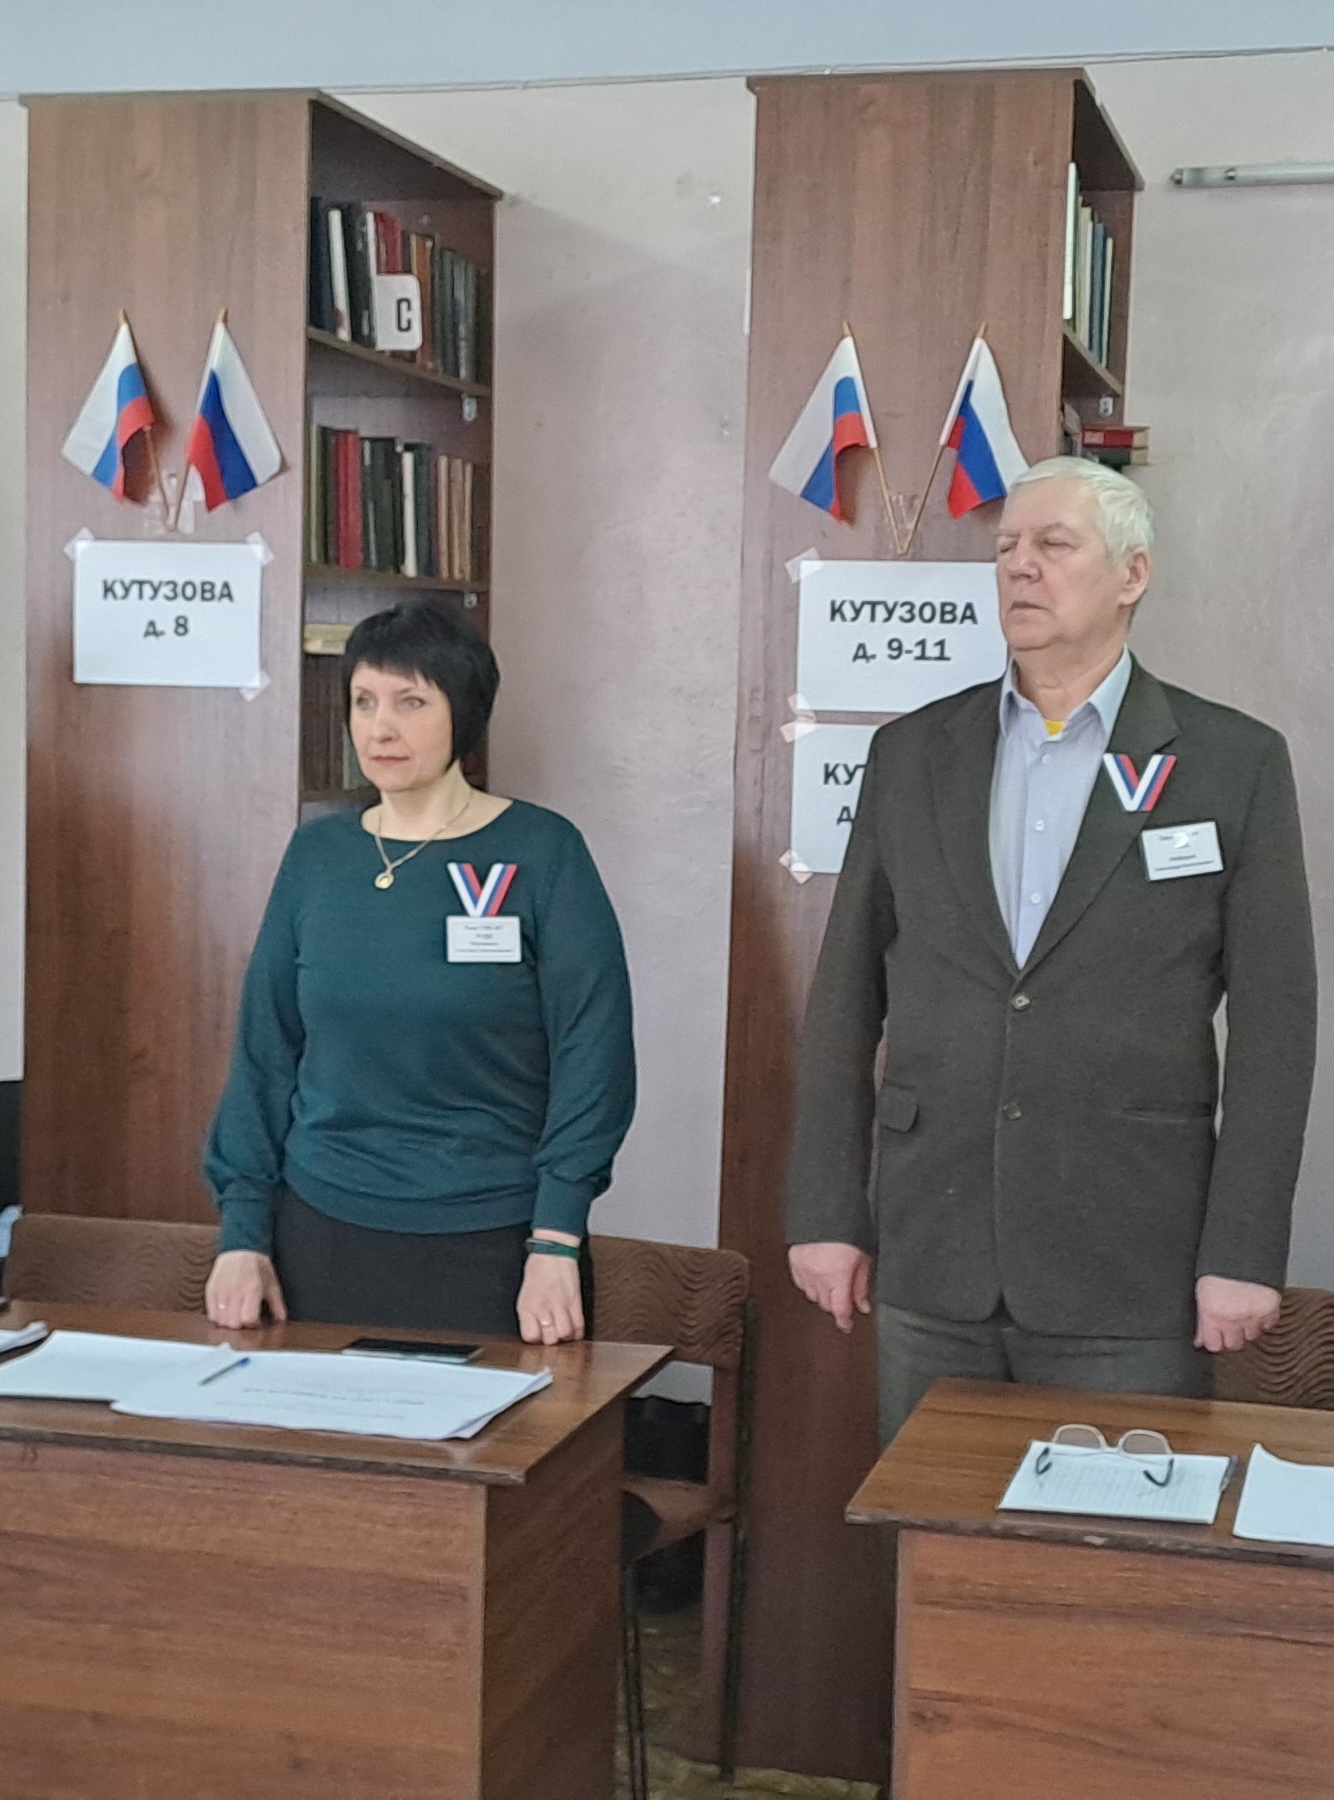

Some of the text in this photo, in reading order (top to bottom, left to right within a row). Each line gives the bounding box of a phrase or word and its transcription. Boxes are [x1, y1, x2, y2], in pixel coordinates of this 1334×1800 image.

[102, 579, 234, 603] КУТУЗОВА
[829, 599, 979, 625] КУТУЗОВА
[143, 615, 189, 638] д. 8
[851, 637, 952, 664] д. 9-11
